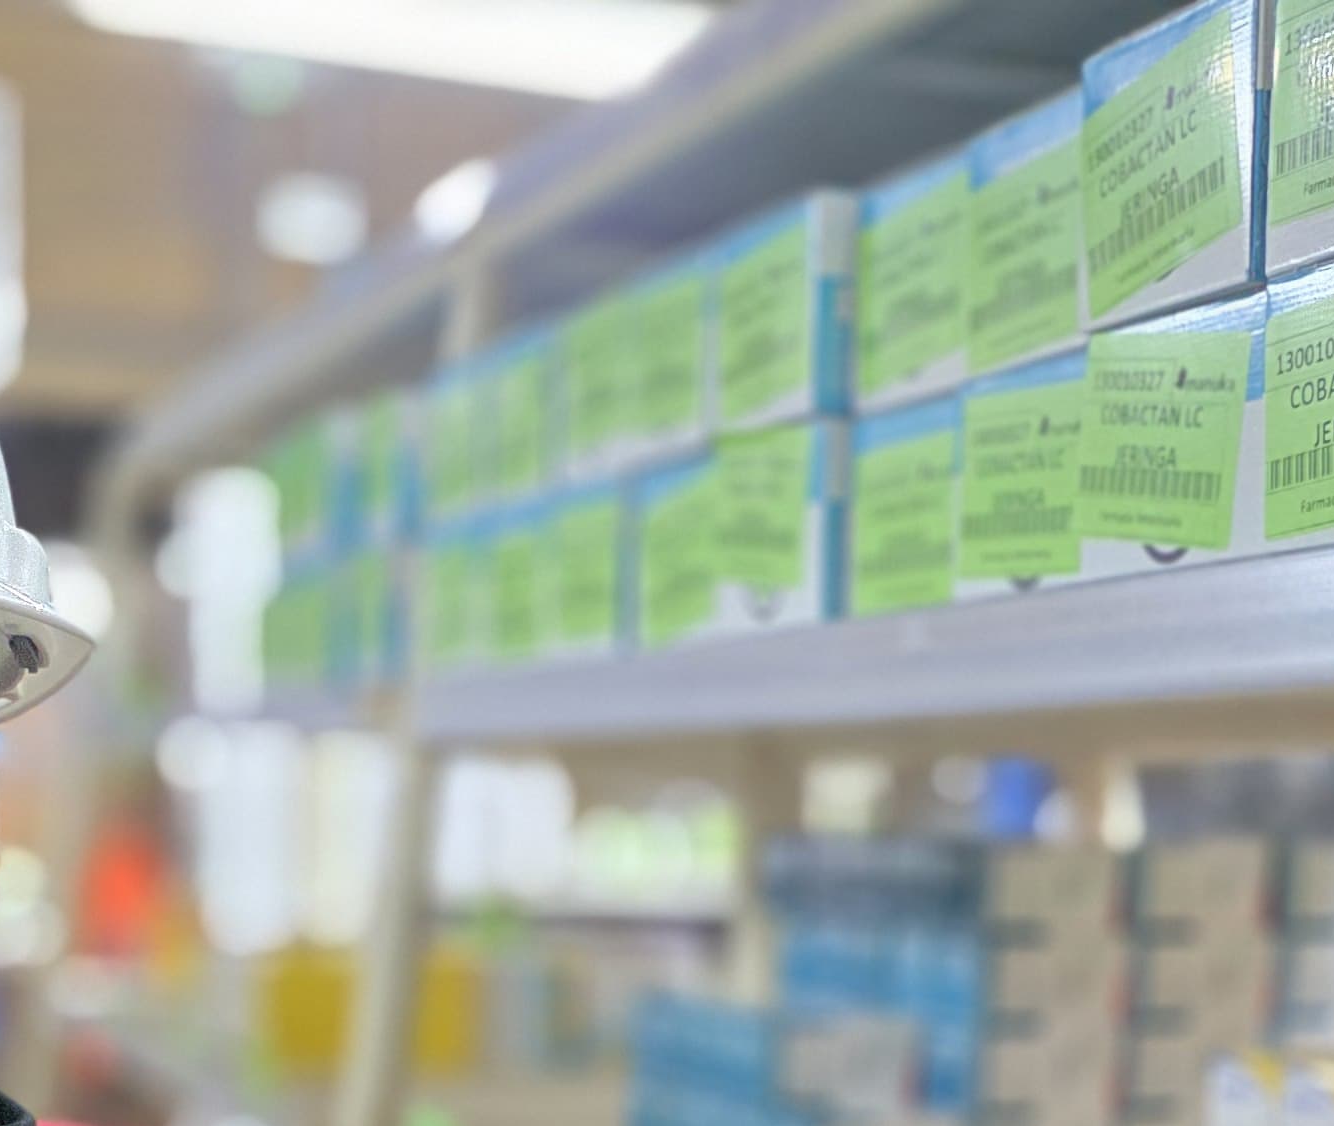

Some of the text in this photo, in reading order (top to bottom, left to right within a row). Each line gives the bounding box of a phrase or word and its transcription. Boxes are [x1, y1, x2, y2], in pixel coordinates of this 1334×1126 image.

[1099, 109, 1196, 198] COBACTAN LC
[1101, 403, 1204, 429] COBACTAN LC
